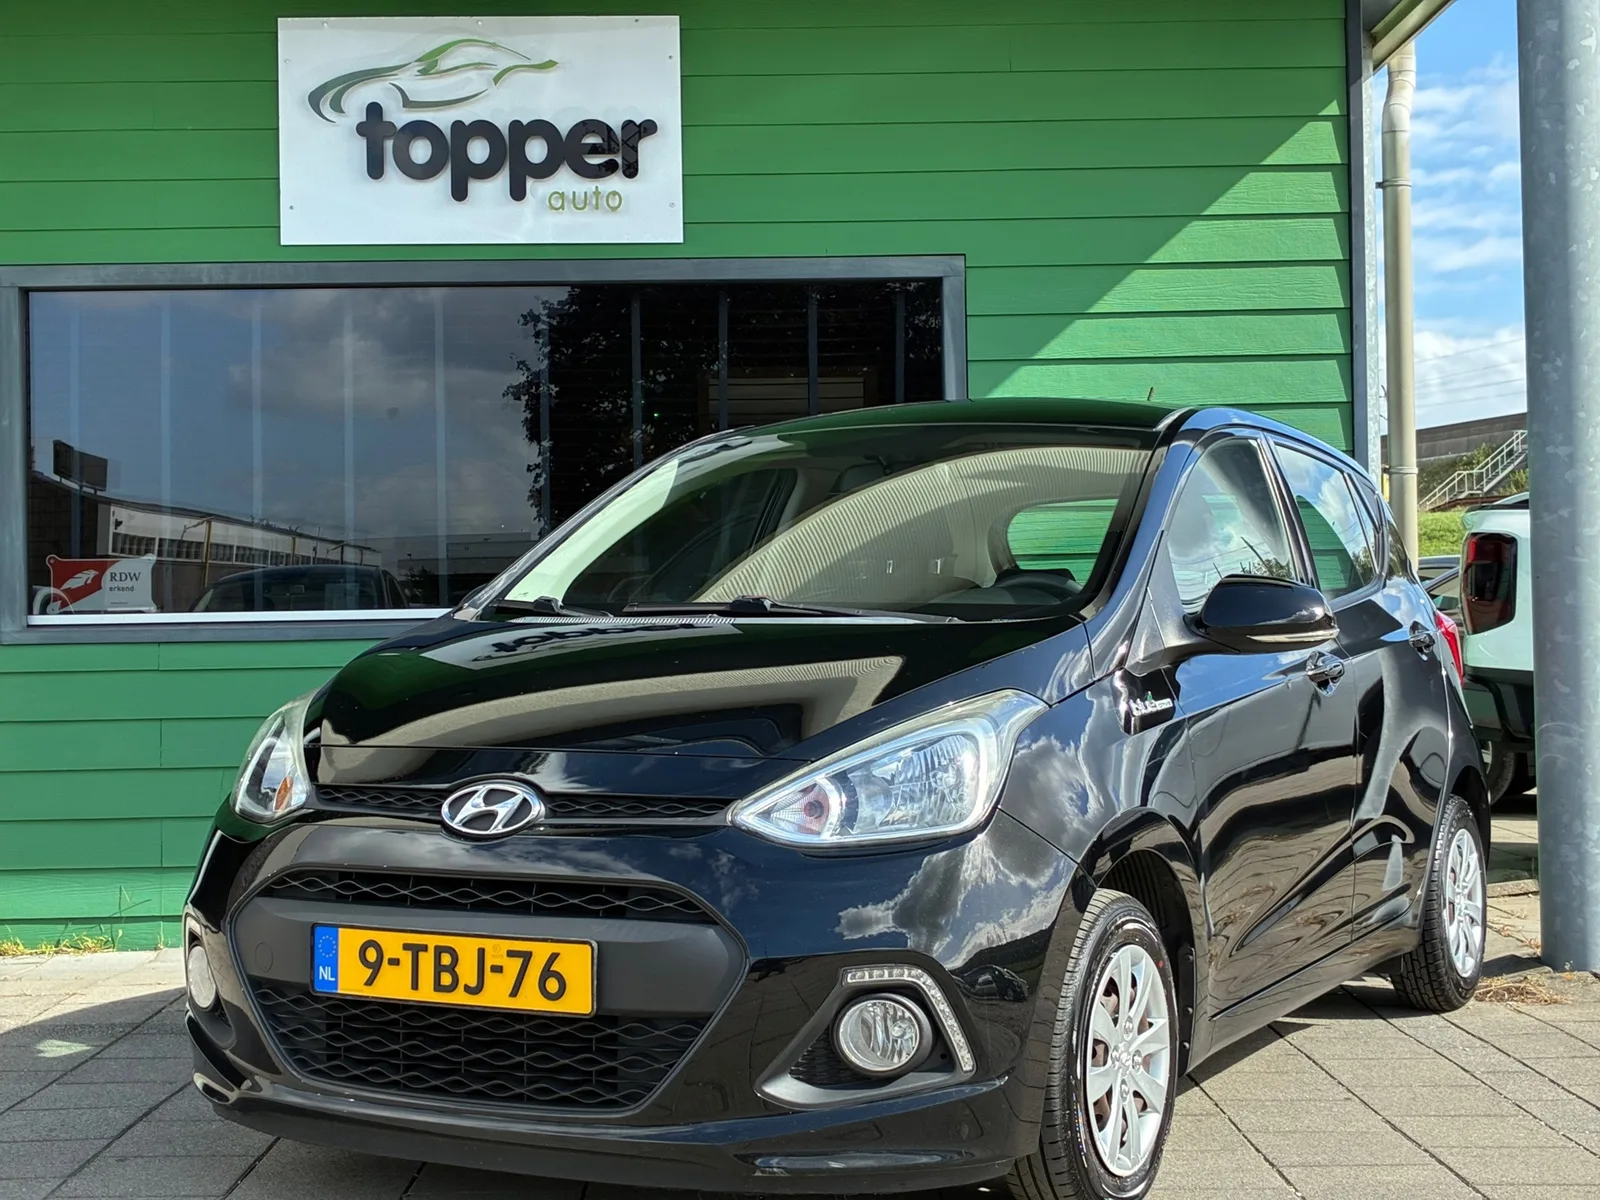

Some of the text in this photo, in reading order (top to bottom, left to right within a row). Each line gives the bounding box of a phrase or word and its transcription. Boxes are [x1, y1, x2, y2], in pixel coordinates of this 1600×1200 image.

[356, 101, 658, 202] topper
[548, 186, 623, 212] auto
[109, 571, 141, 582] RDW
[319, 965, 335, 981] NL
[358, 939, 567, 1001] 9-TBJ-76
